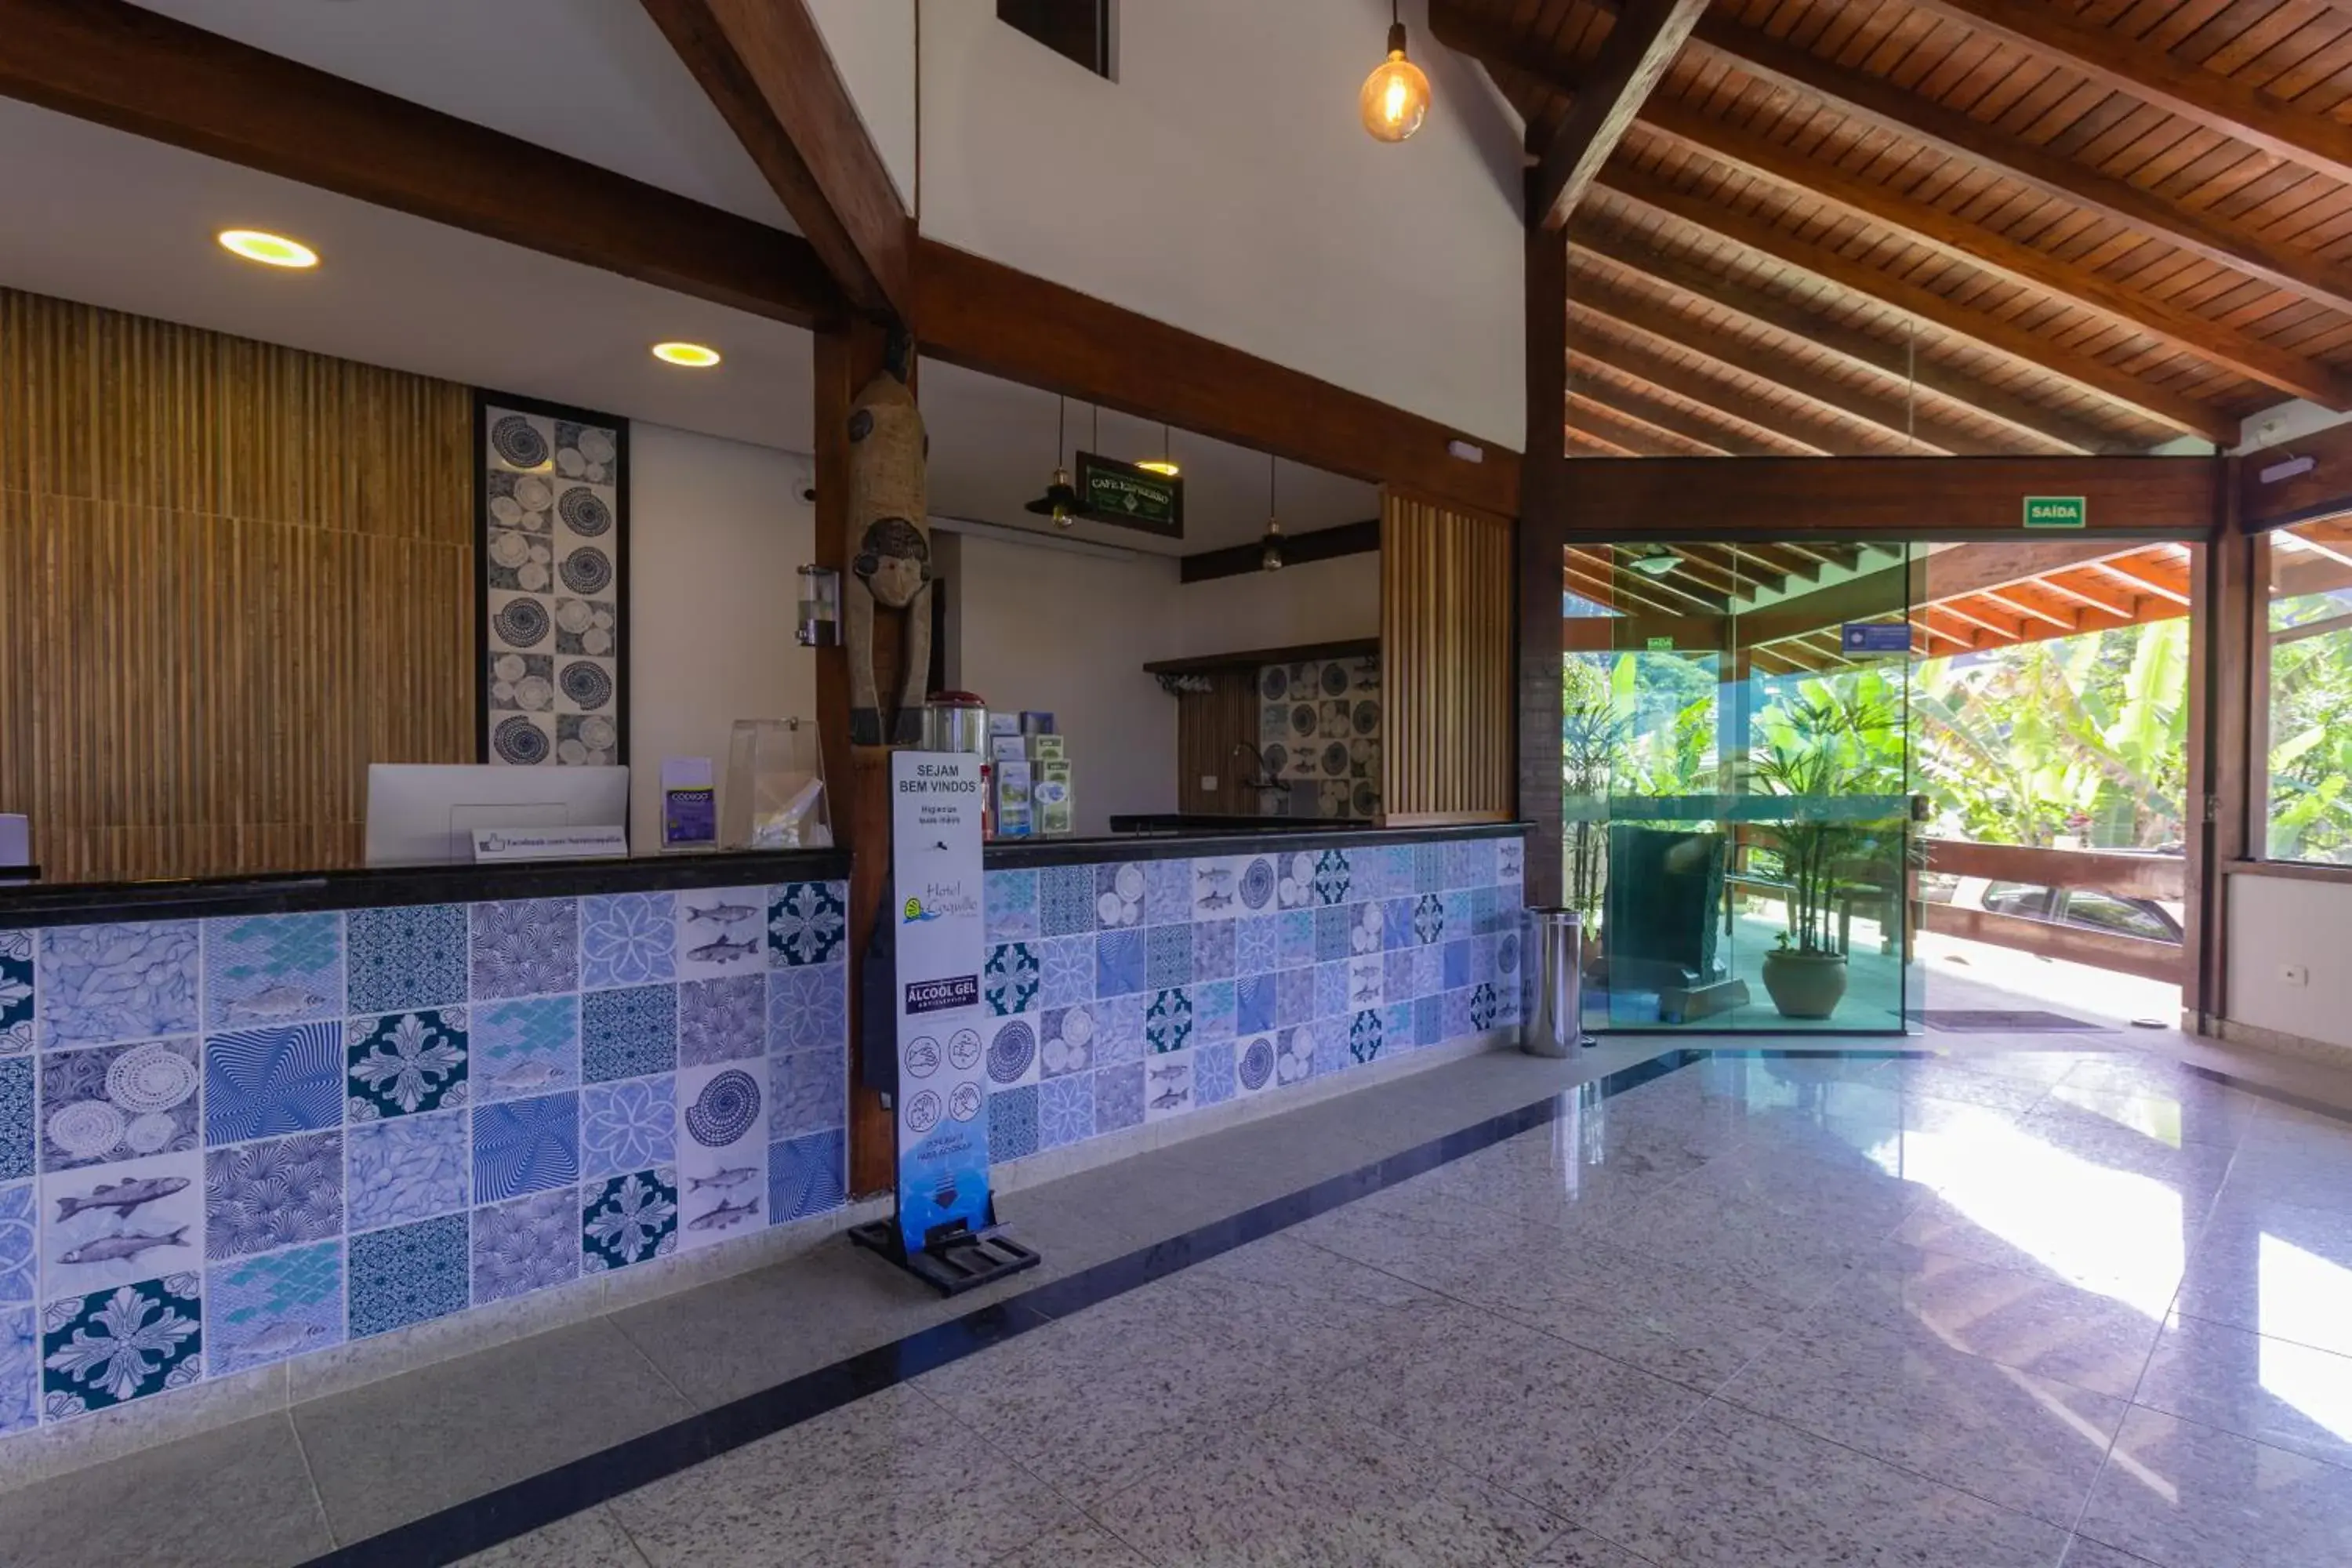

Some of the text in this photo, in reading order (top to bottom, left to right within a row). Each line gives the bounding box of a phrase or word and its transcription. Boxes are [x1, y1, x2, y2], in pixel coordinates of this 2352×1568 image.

[2031, 504, 2078, 518] SAÍDA
[916, 764, 959, 777] SEJAM
[899, 780, 977, 793] BEM VINDOS
[927, 880, 960, 898] Hotel
[955, 982, 976, 995] GEL
